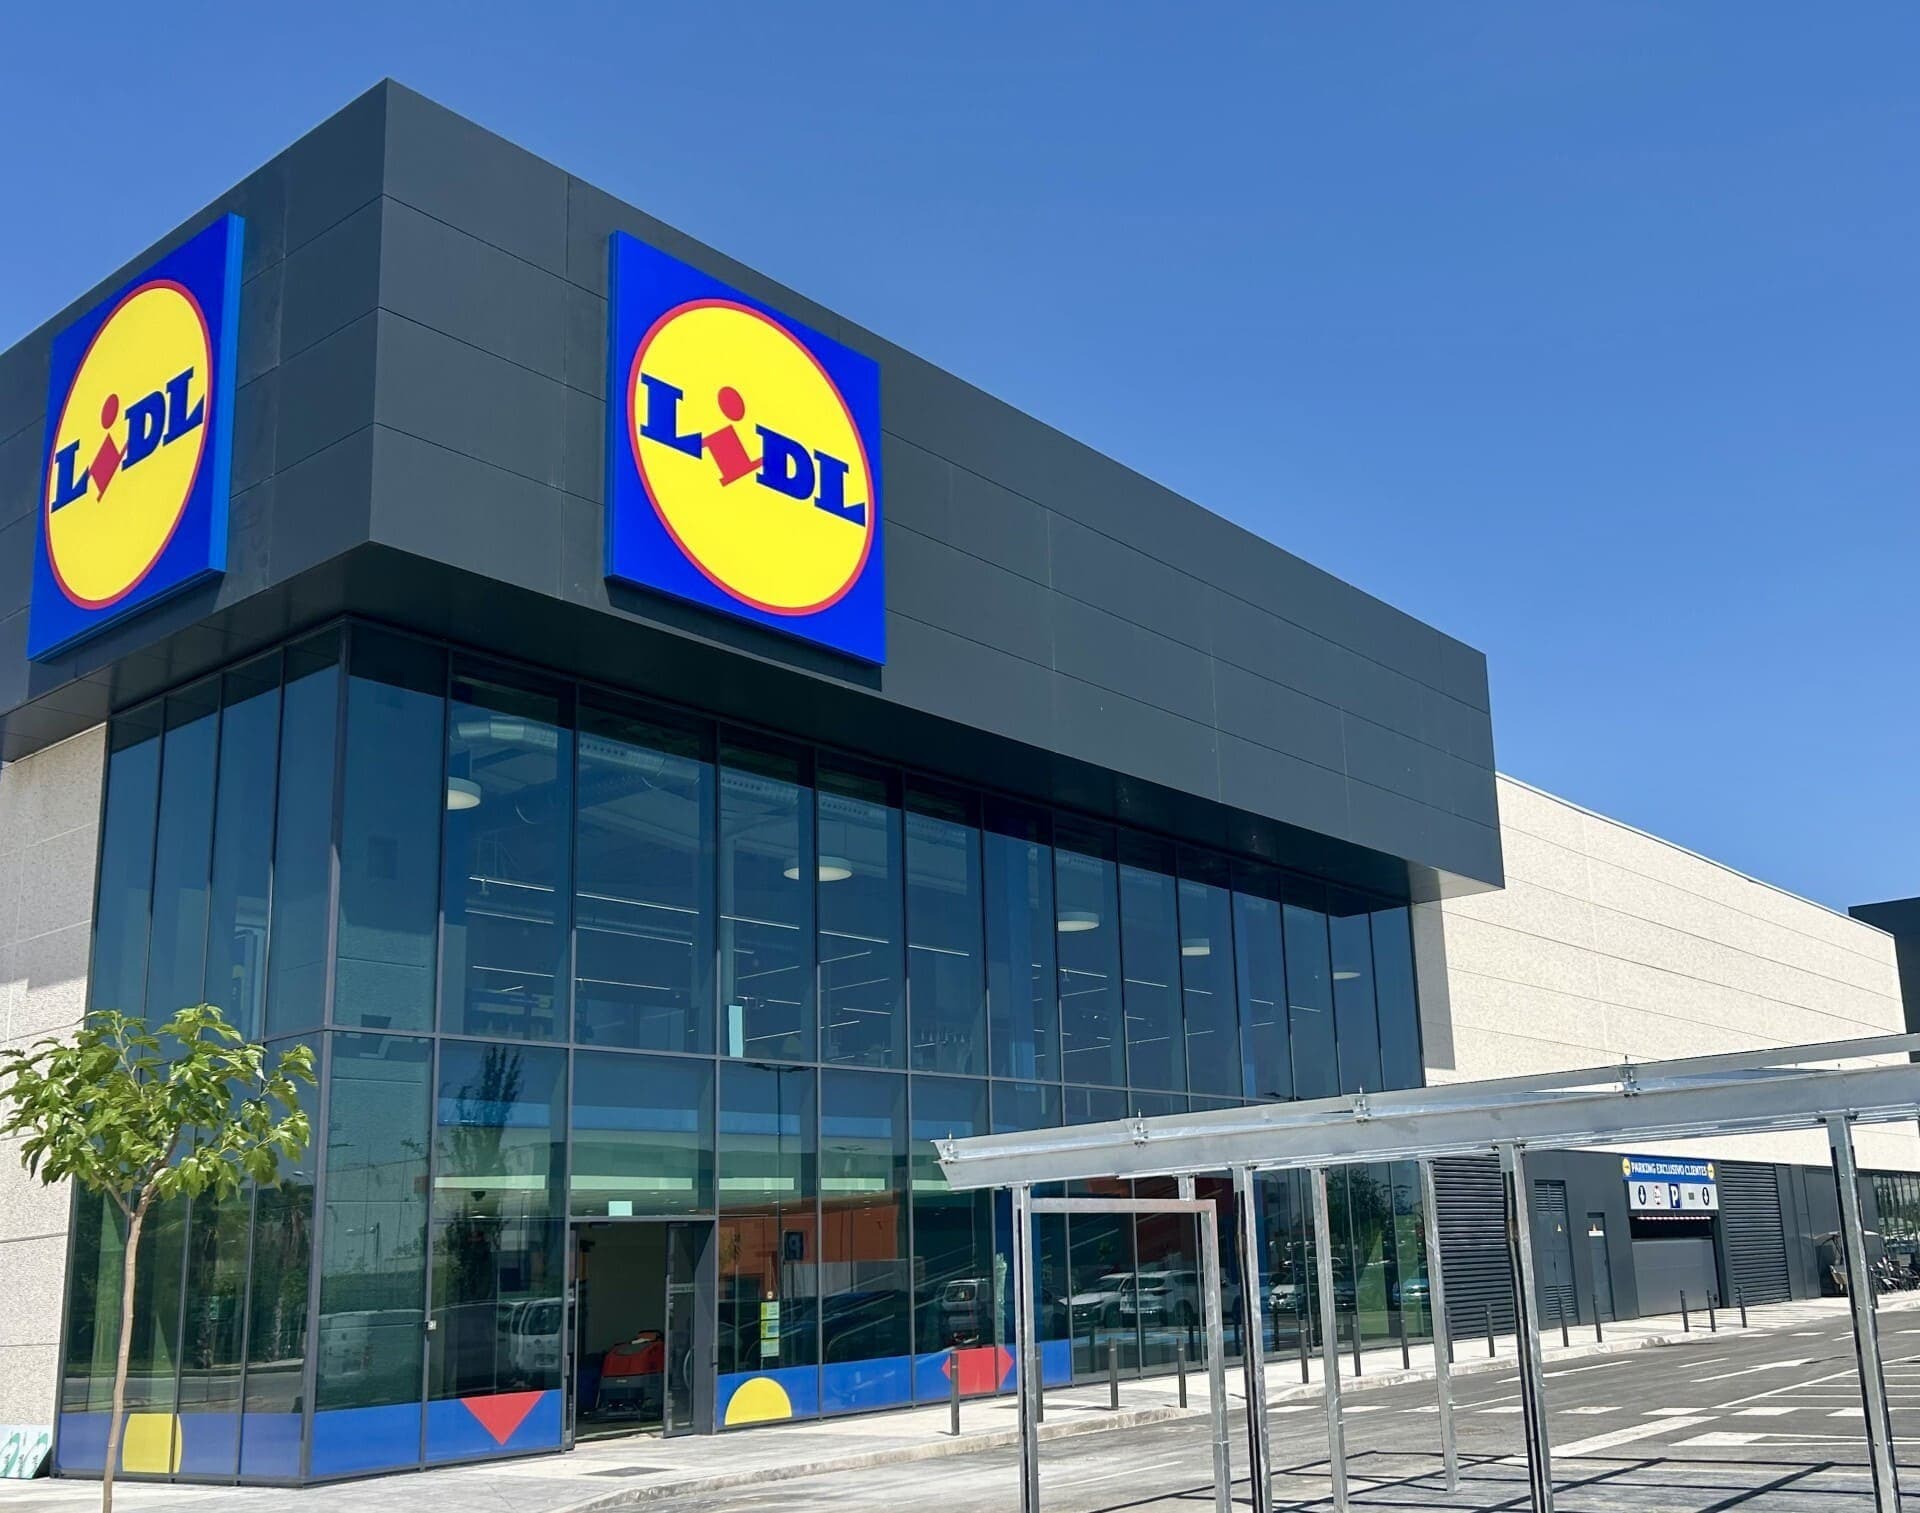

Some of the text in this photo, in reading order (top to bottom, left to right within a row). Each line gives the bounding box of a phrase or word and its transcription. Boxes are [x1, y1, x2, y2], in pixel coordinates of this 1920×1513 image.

[1631, 1162, 1708, 1176] PARKING EXCLUSIVO CLIENTES
[1670, 1185, 1679, 1207] P
